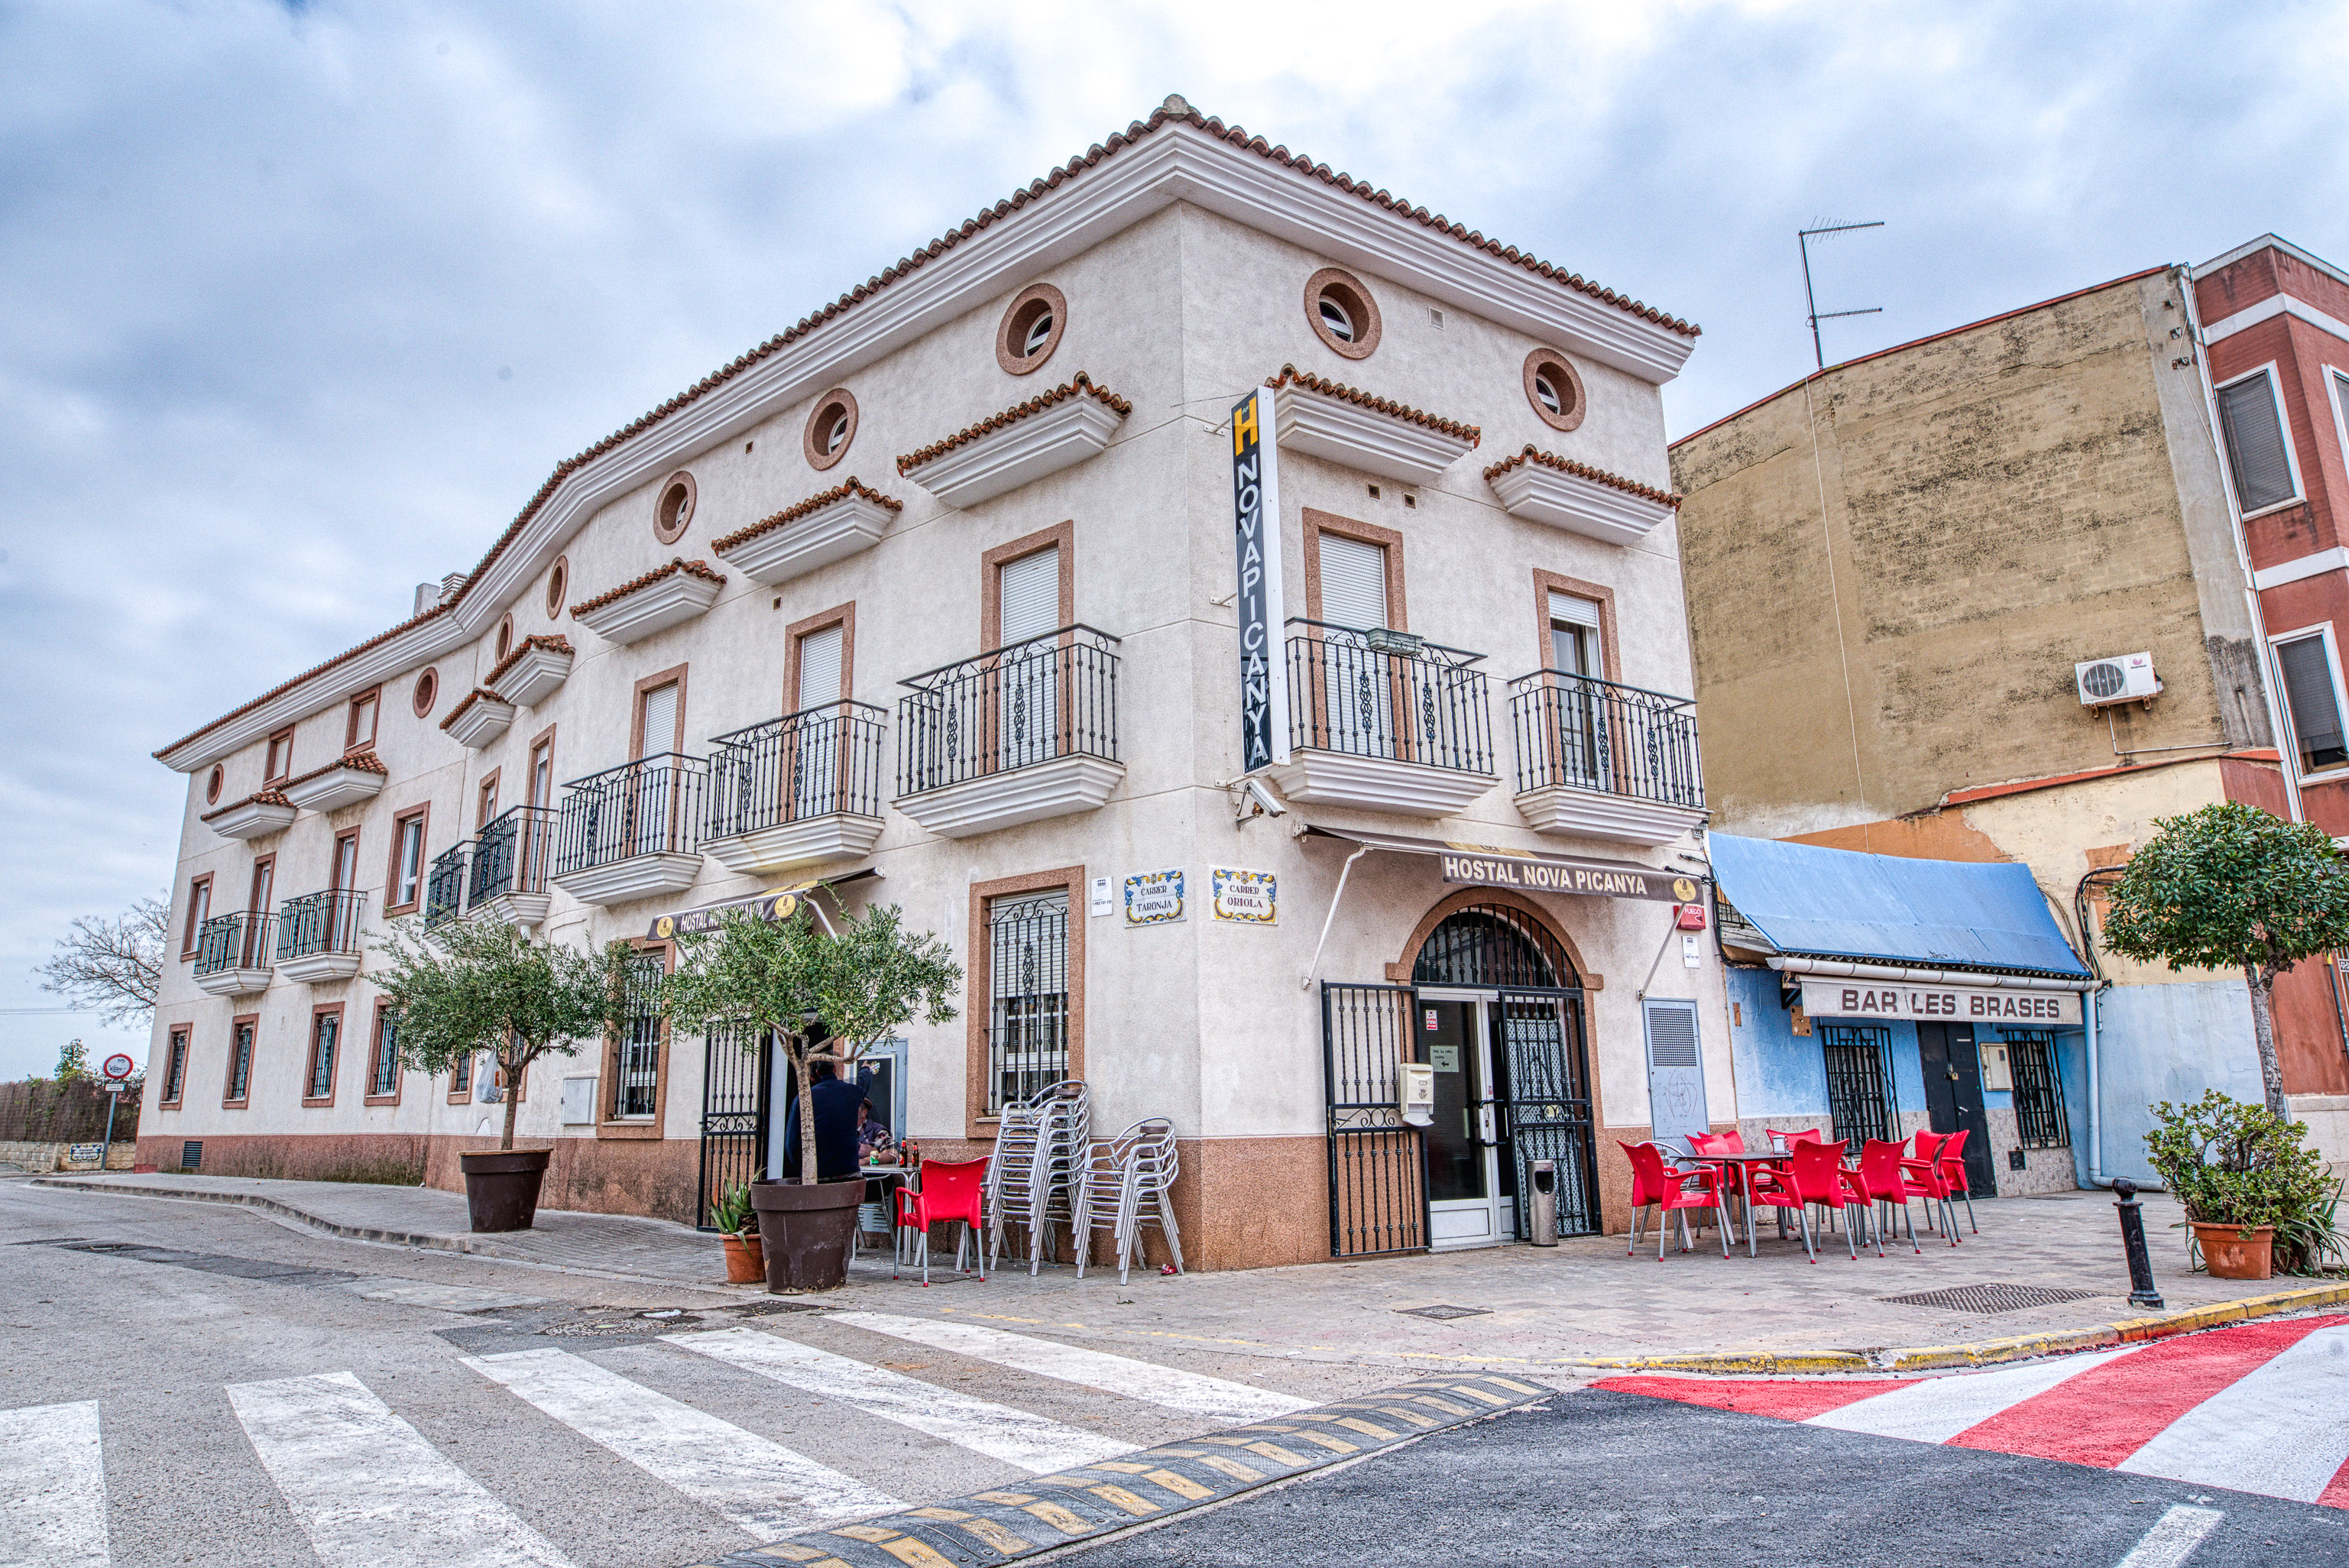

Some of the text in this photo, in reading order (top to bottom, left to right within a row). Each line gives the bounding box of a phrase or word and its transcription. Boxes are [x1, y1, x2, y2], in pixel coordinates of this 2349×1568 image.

[1234, 396, 1259, 457] H
[1445, 857, 1648, 895] HOSTAL NOVA PICANYA
[1140, 885, 1167, 896] CARRER
[1230, 884, 1259, 895] CARRER
[1136, 900, 1172, 912] TARONJA
[1227, 896, 1263, 909] ORIOLA
[680, 912, 707, 931] HOSTAL
[1842, 989, 2060, 1019] BAR LES BRASES
